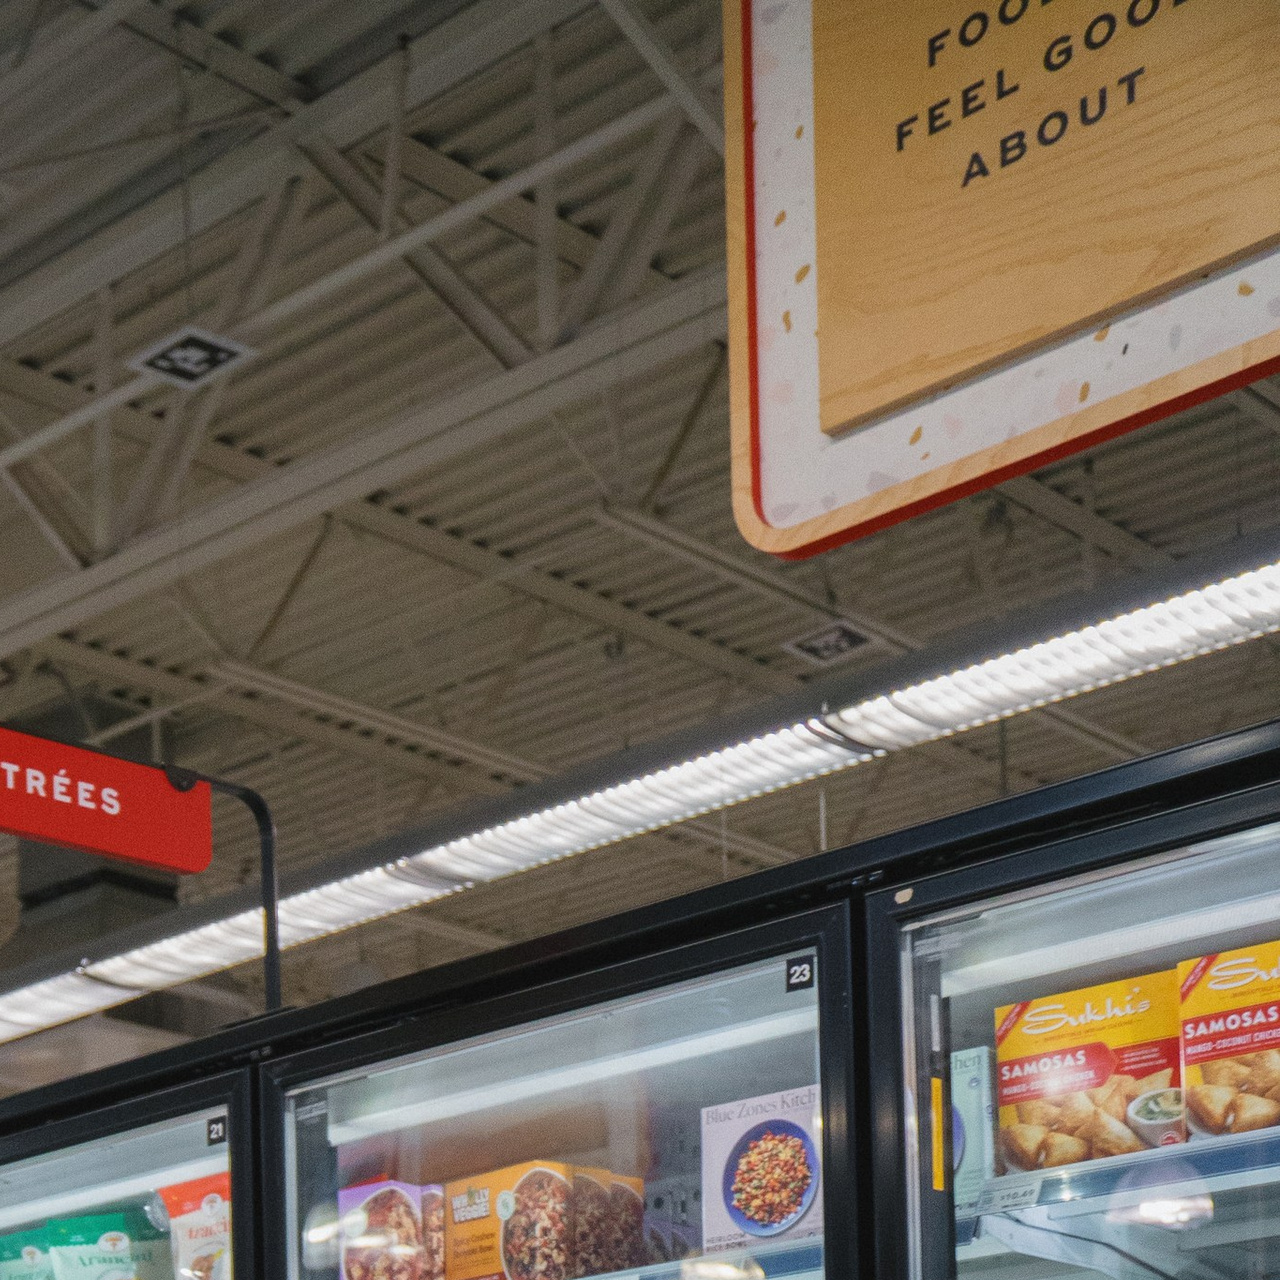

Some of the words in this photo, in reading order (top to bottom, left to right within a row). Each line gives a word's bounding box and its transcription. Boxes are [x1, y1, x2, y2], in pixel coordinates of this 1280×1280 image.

[928, 0, 1057, 67] FOO
[896, 69, 1019, 151] FEEL
[1043, 0, 1185, 71] GOO
[961, 67, 1146, 188] ABOUT
[789, 963, 811, 984] 23
[1021, 987, 1151, 1035] Sukhi's
[1184, 1005, 1278, 1039] SAMOSAS
[1001, 1050, 1086, 1081] SAMOSAS
[209, 1122, 224, 1139] 21
[705, 1109, 734, 1125] Blue
[736, 1102, 777, 1119] Zones
